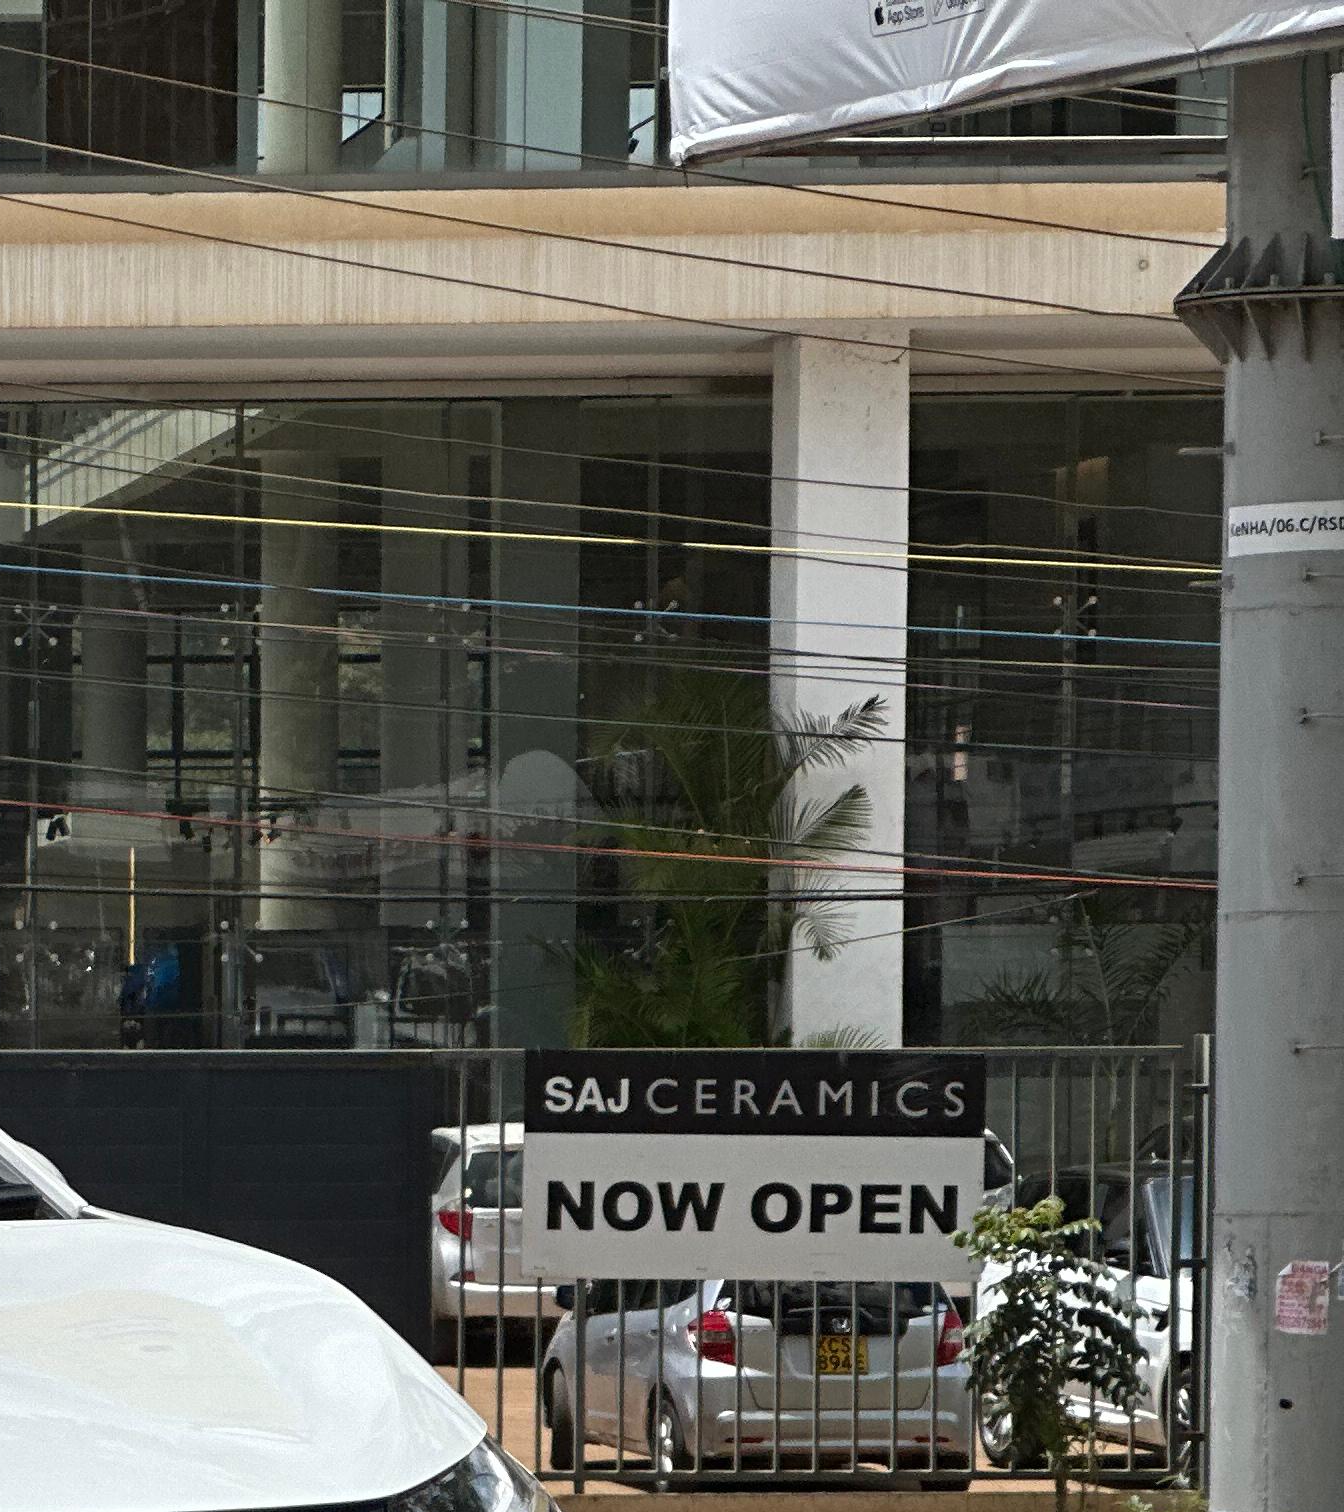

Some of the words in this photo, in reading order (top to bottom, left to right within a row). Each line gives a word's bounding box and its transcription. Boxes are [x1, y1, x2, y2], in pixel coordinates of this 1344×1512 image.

[544, 1076, 631, 1114] SAJ
[645, 1078, 966, 1118] CERAMICS
[546, 1180, 726, 1233] NOW
[750, 1182, 959, 1235] OPEN
